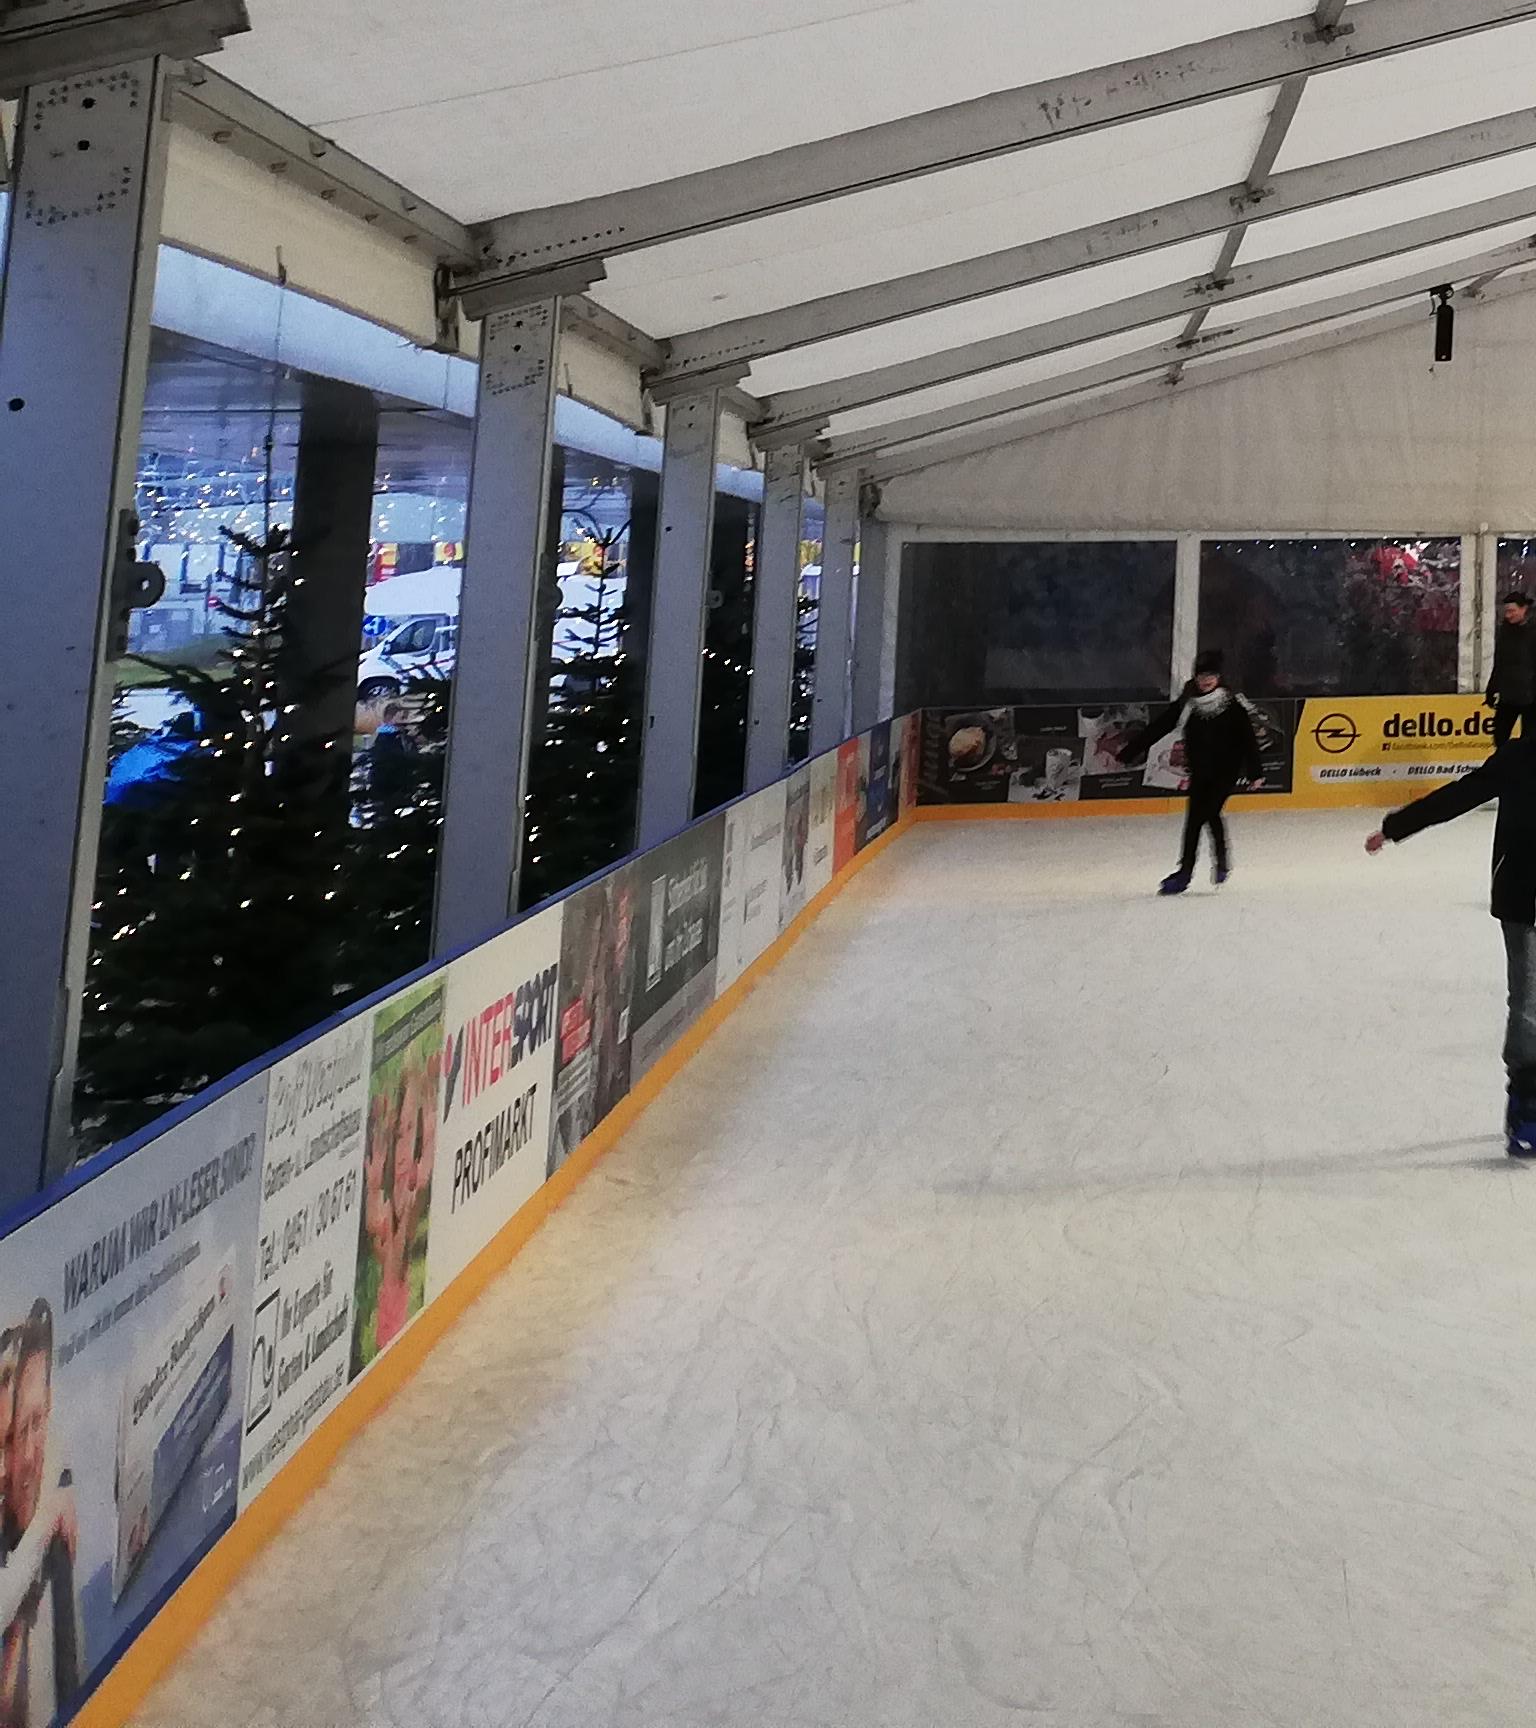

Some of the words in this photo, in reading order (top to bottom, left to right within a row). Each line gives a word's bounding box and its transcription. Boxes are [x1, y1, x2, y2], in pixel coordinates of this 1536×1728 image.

[1383, 711, 1496, 739] dello.de
[463, 962, 558, 1108] INTERSPORT
[451, 1083, 538, 1216] PROFIMARKT
